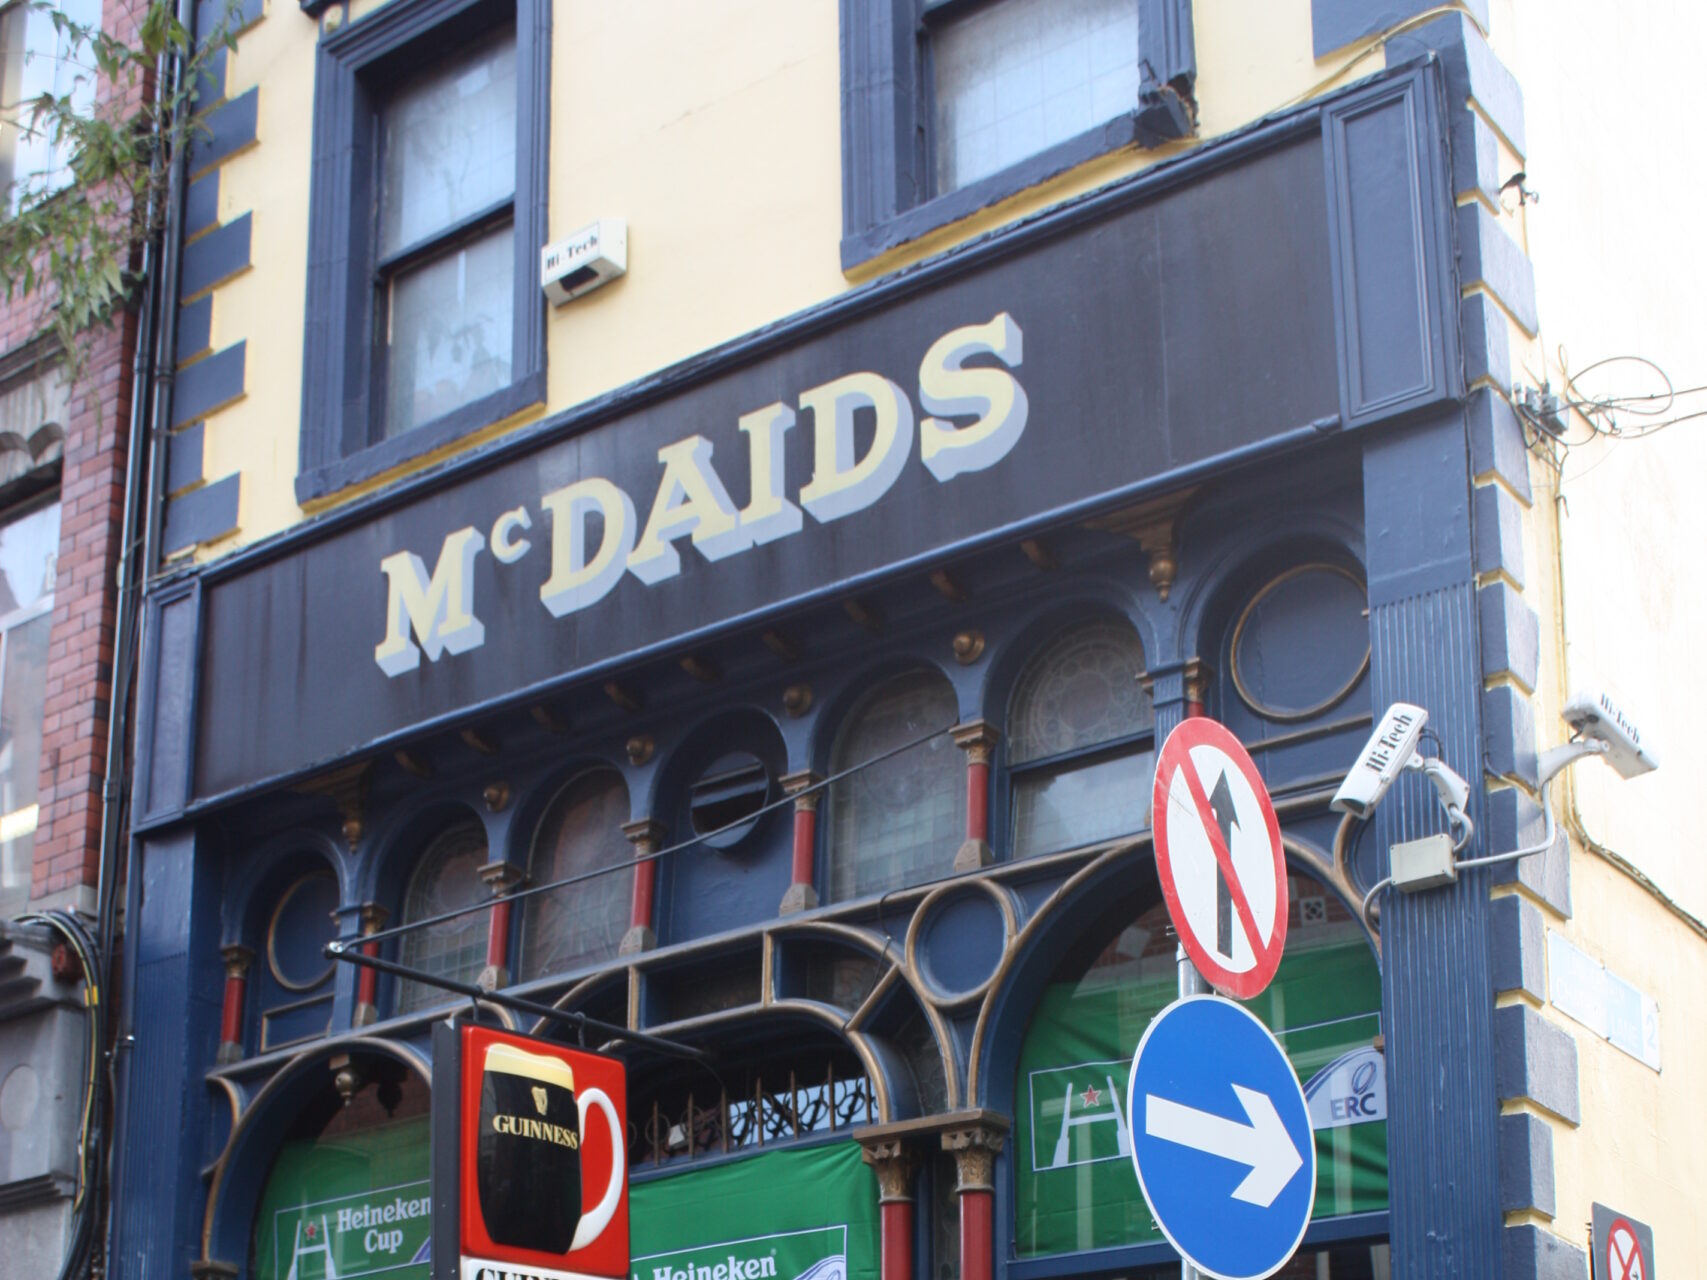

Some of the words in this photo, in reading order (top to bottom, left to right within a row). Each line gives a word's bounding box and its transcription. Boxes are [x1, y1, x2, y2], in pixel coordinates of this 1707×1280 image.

[1365, 712, 1413, 773] Hi-Tech
[1330, 1093, 1377, 1120] ERC
[492, 1114, 579, 1150] GUINNESS
[337, 1197, 432, 1233] Heineken
[363, 1228, 403, 1254] Cup
